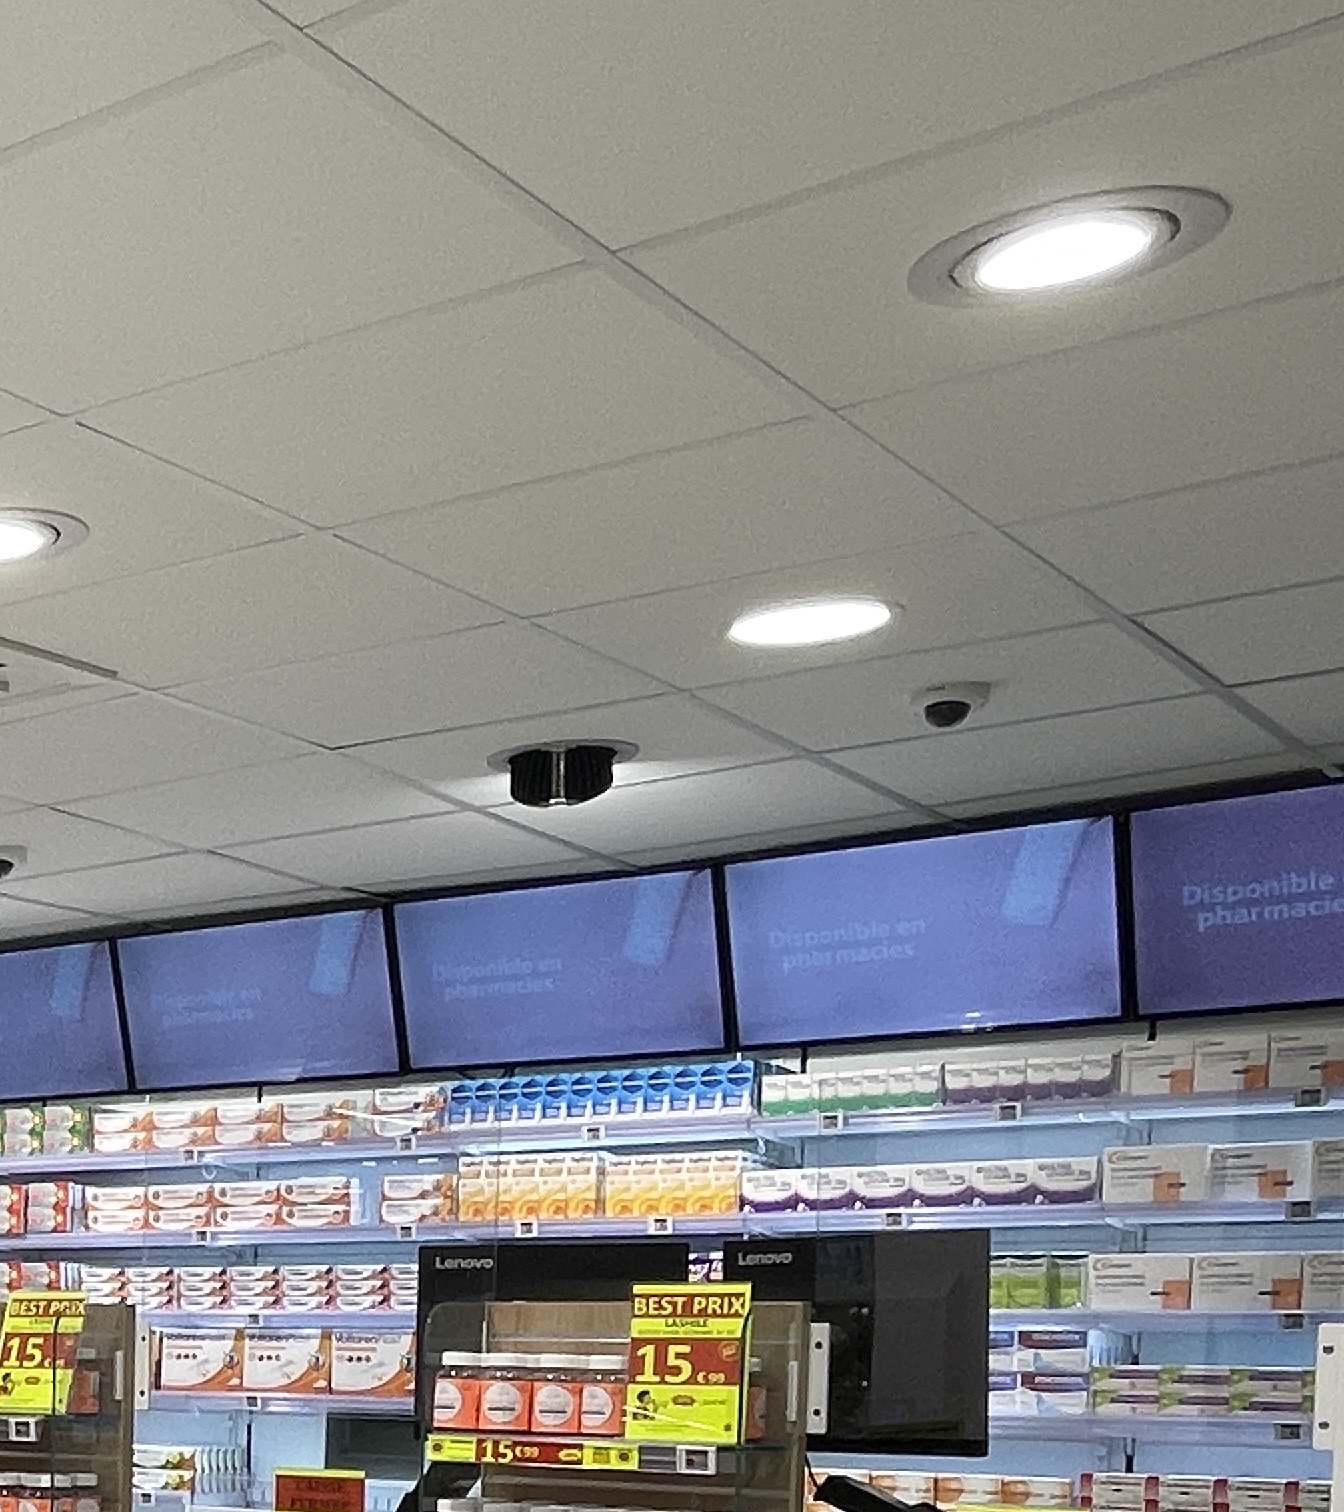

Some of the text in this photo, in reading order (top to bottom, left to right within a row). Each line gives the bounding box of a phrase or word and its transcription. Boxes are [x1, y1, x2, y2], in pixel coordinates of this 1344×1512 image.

[1183, 868, 1334, 906] Disponible
[768, 919, 890, 949] Disponible
[436, 1256, 493, 1270] Lenovo
[738, 1252, 792, 1265] Lenovo
[11, 1300, 48, 1315] BEST
[634, 1296, 746, 1316] BEST PRIX
[3, 1336, 44, 1368] 15
[635, 1343, 693, 1384] 15
[479, 1440, 515, 1463] 15
